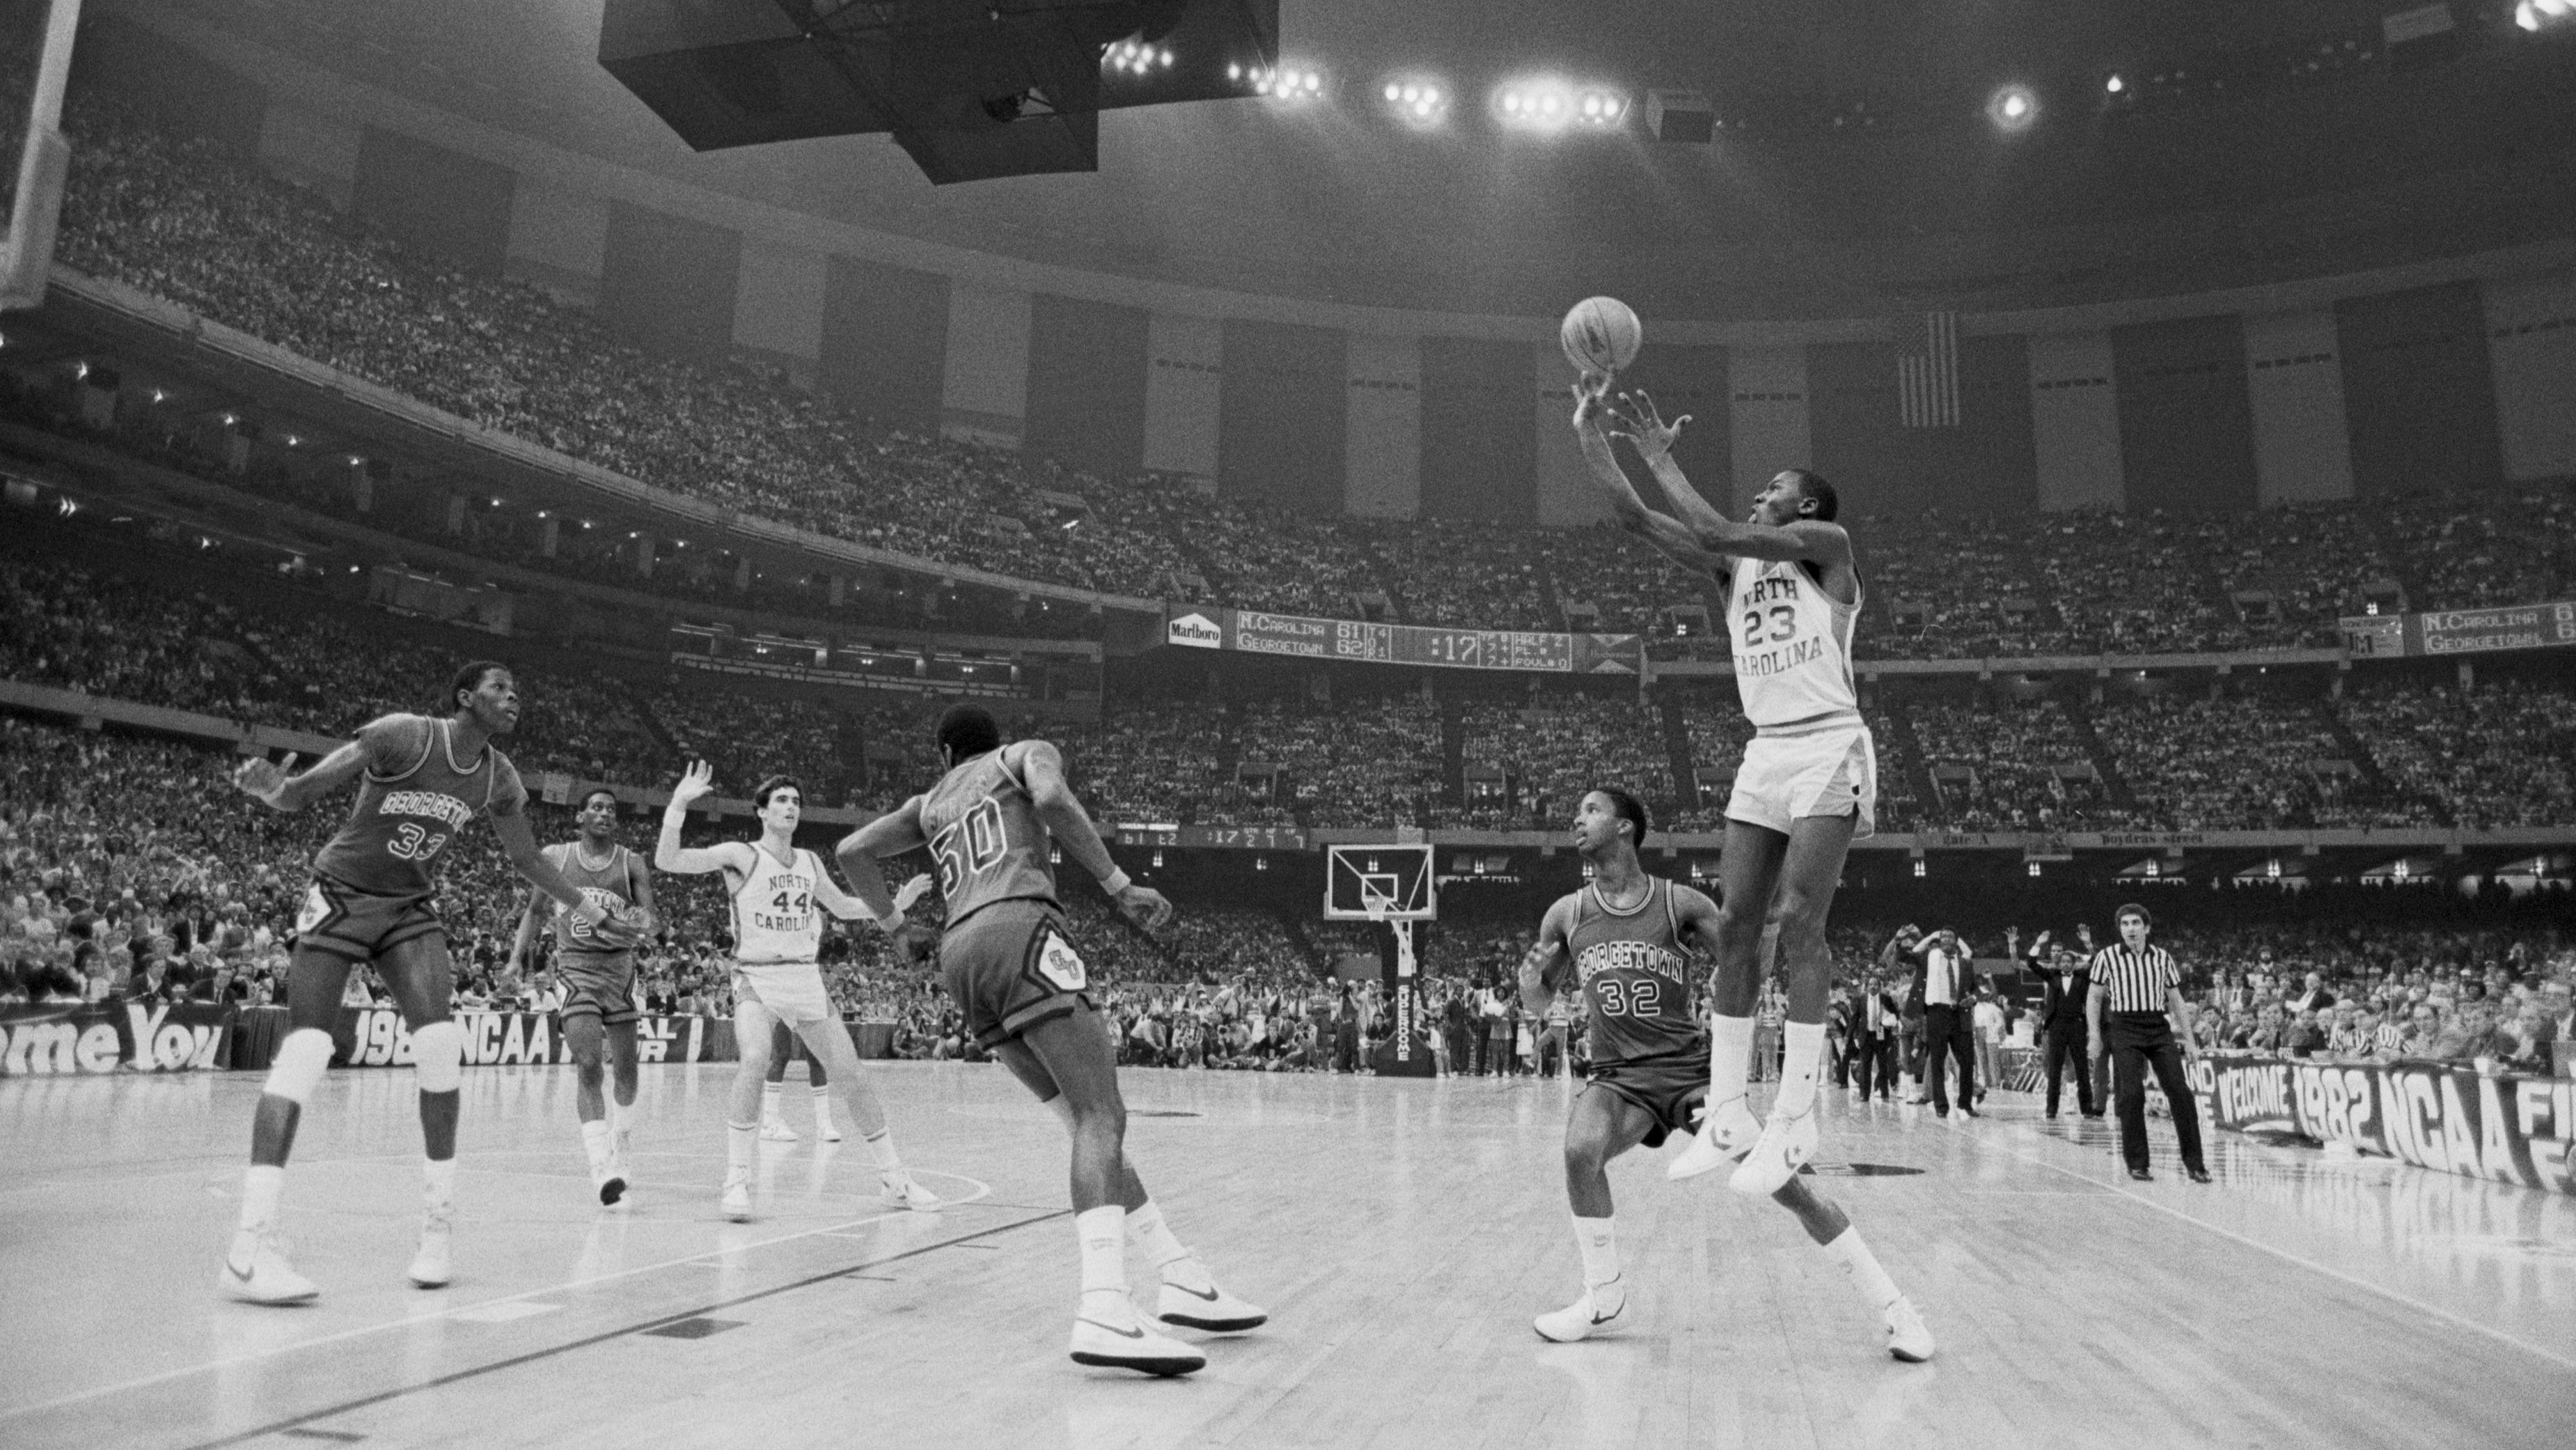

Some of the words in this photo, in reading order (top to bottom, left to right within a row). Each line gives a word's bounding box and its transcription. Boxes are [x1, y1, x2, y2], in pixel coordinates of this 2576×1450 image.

[1171, 623, 1220, 641] Marlboro
[1239, 632, 1324, 655] GEORGETOWN
[1337, 639, 1363, 655] 62
[1337, 622, 1359, 639] 61
[1744, 605, 1796, 648] 23
[387, 822, 446, 860] 33
[928, 795, 1008, 901] 50
[769, 873, 811, 892] NORTH
[772, 891, 808, 914] 44
[1597, 979, 1661, 1017] 32
[127, 1004, 223, 1070] You
[350, 1009, 417, 1066] 198
[454, 1013, 550, 1065] NCAA
[1397, 984, 1411, 1061] SUPERDOME
[2217, 1065, 2290, 1123] WELCOME
[2292, 1066, 2382, 1153] 1982
[2377, 1071, 2527, 1187] NCAA
